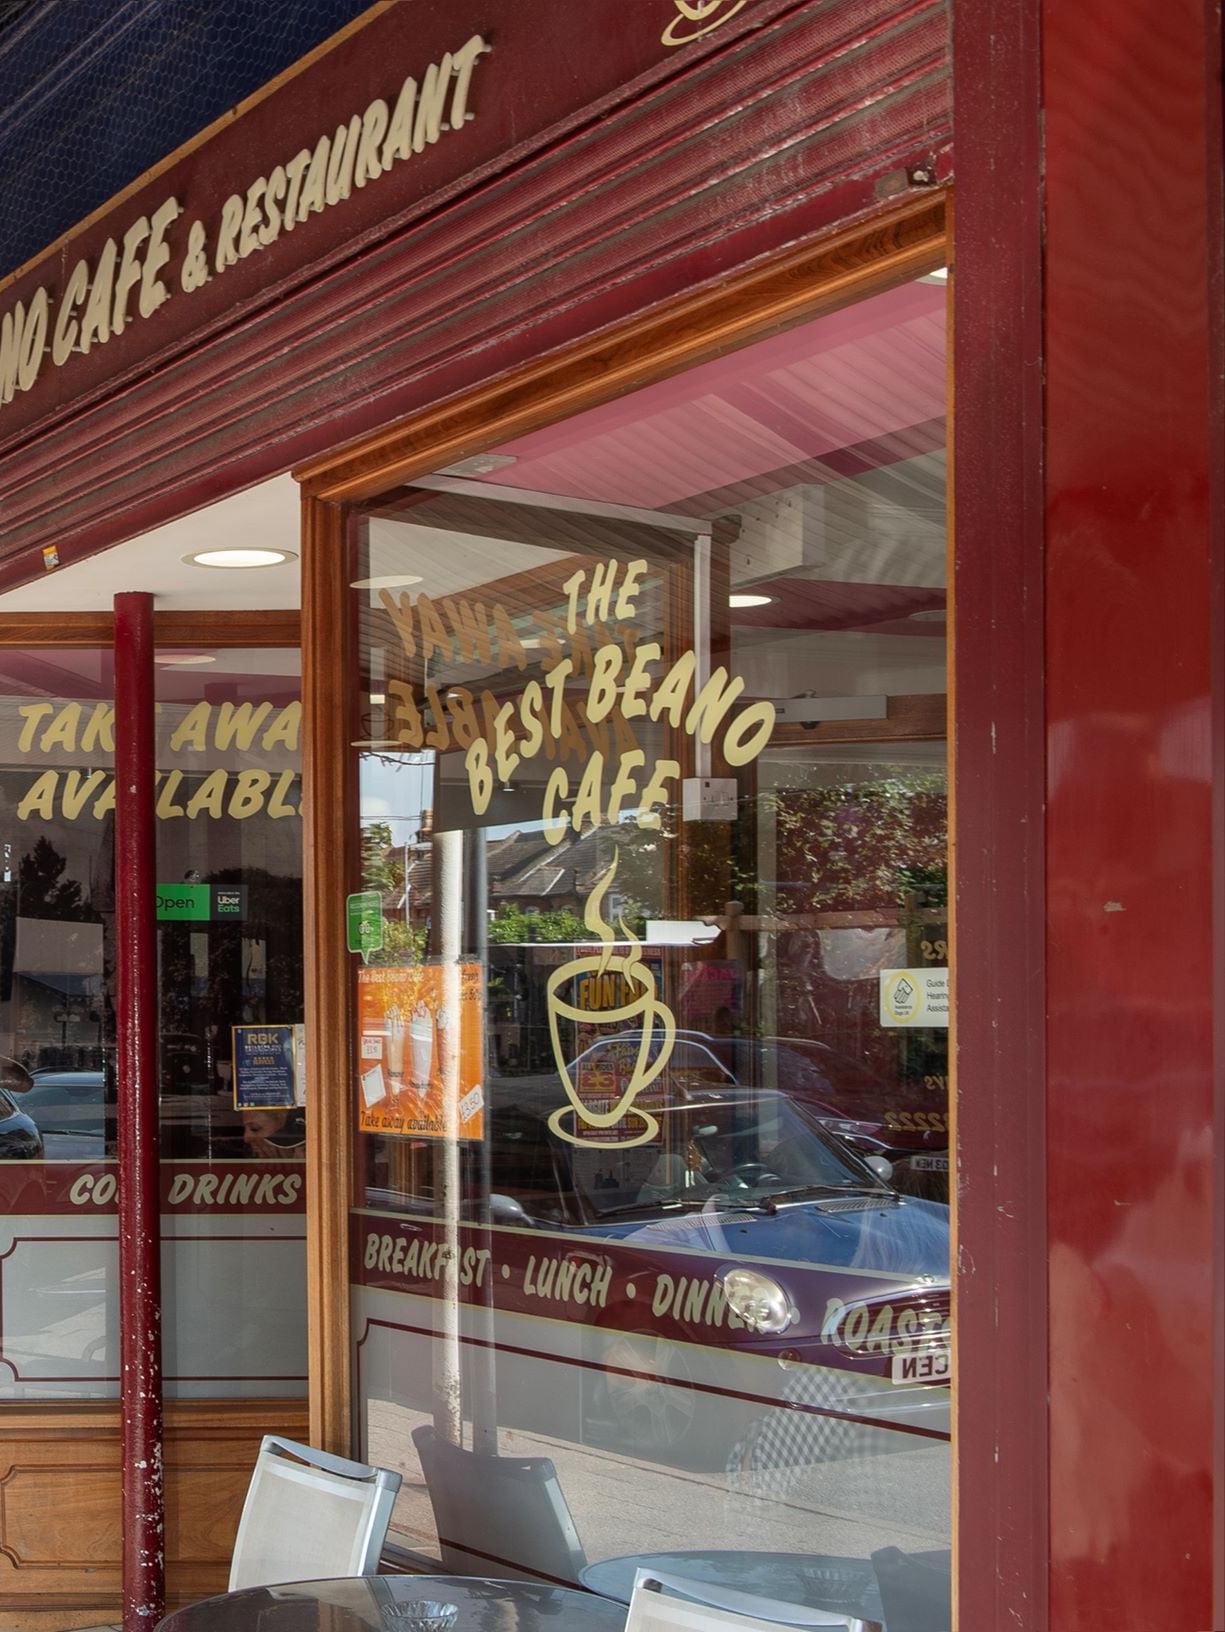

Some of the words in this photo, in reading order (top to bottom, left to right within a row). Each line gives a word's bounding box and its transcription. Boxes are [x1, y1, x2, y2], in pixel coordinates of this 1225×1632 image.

[52, 196, 179, 366] CAFE
[181, 220, 207, 293] &
[215, 34, 485, 273] RESTAURANT
[563, 558, 648, 635] THE
[18, 701, 162, 752] TAK
[170, 700, 303, 751] AWA
[464, 659, 573, 815] BEST
[586, 643, 777, 767] BEANO
[17, 769, 303, 820] AVLABL
[543, 750, 680, 847] CAFE
[156, 896, 194, 911] Open
[217, 895, 240, 904] Uber
[217, 904, 240, 913] Eats
[247, 1033, 279, 1045] RBK
[361, 1110, 380, 1128] Take
[382, 1116, 405, 1133] away
[70, 1173, 119, 1206] CO
[167, 1173, 302, 1206] DRINKS
[364, 1232, 491, 1288] BREAKFST
[523, 1254, 613, 1308] LUNCH
[820, 1297, 950, 1358] ROAST
